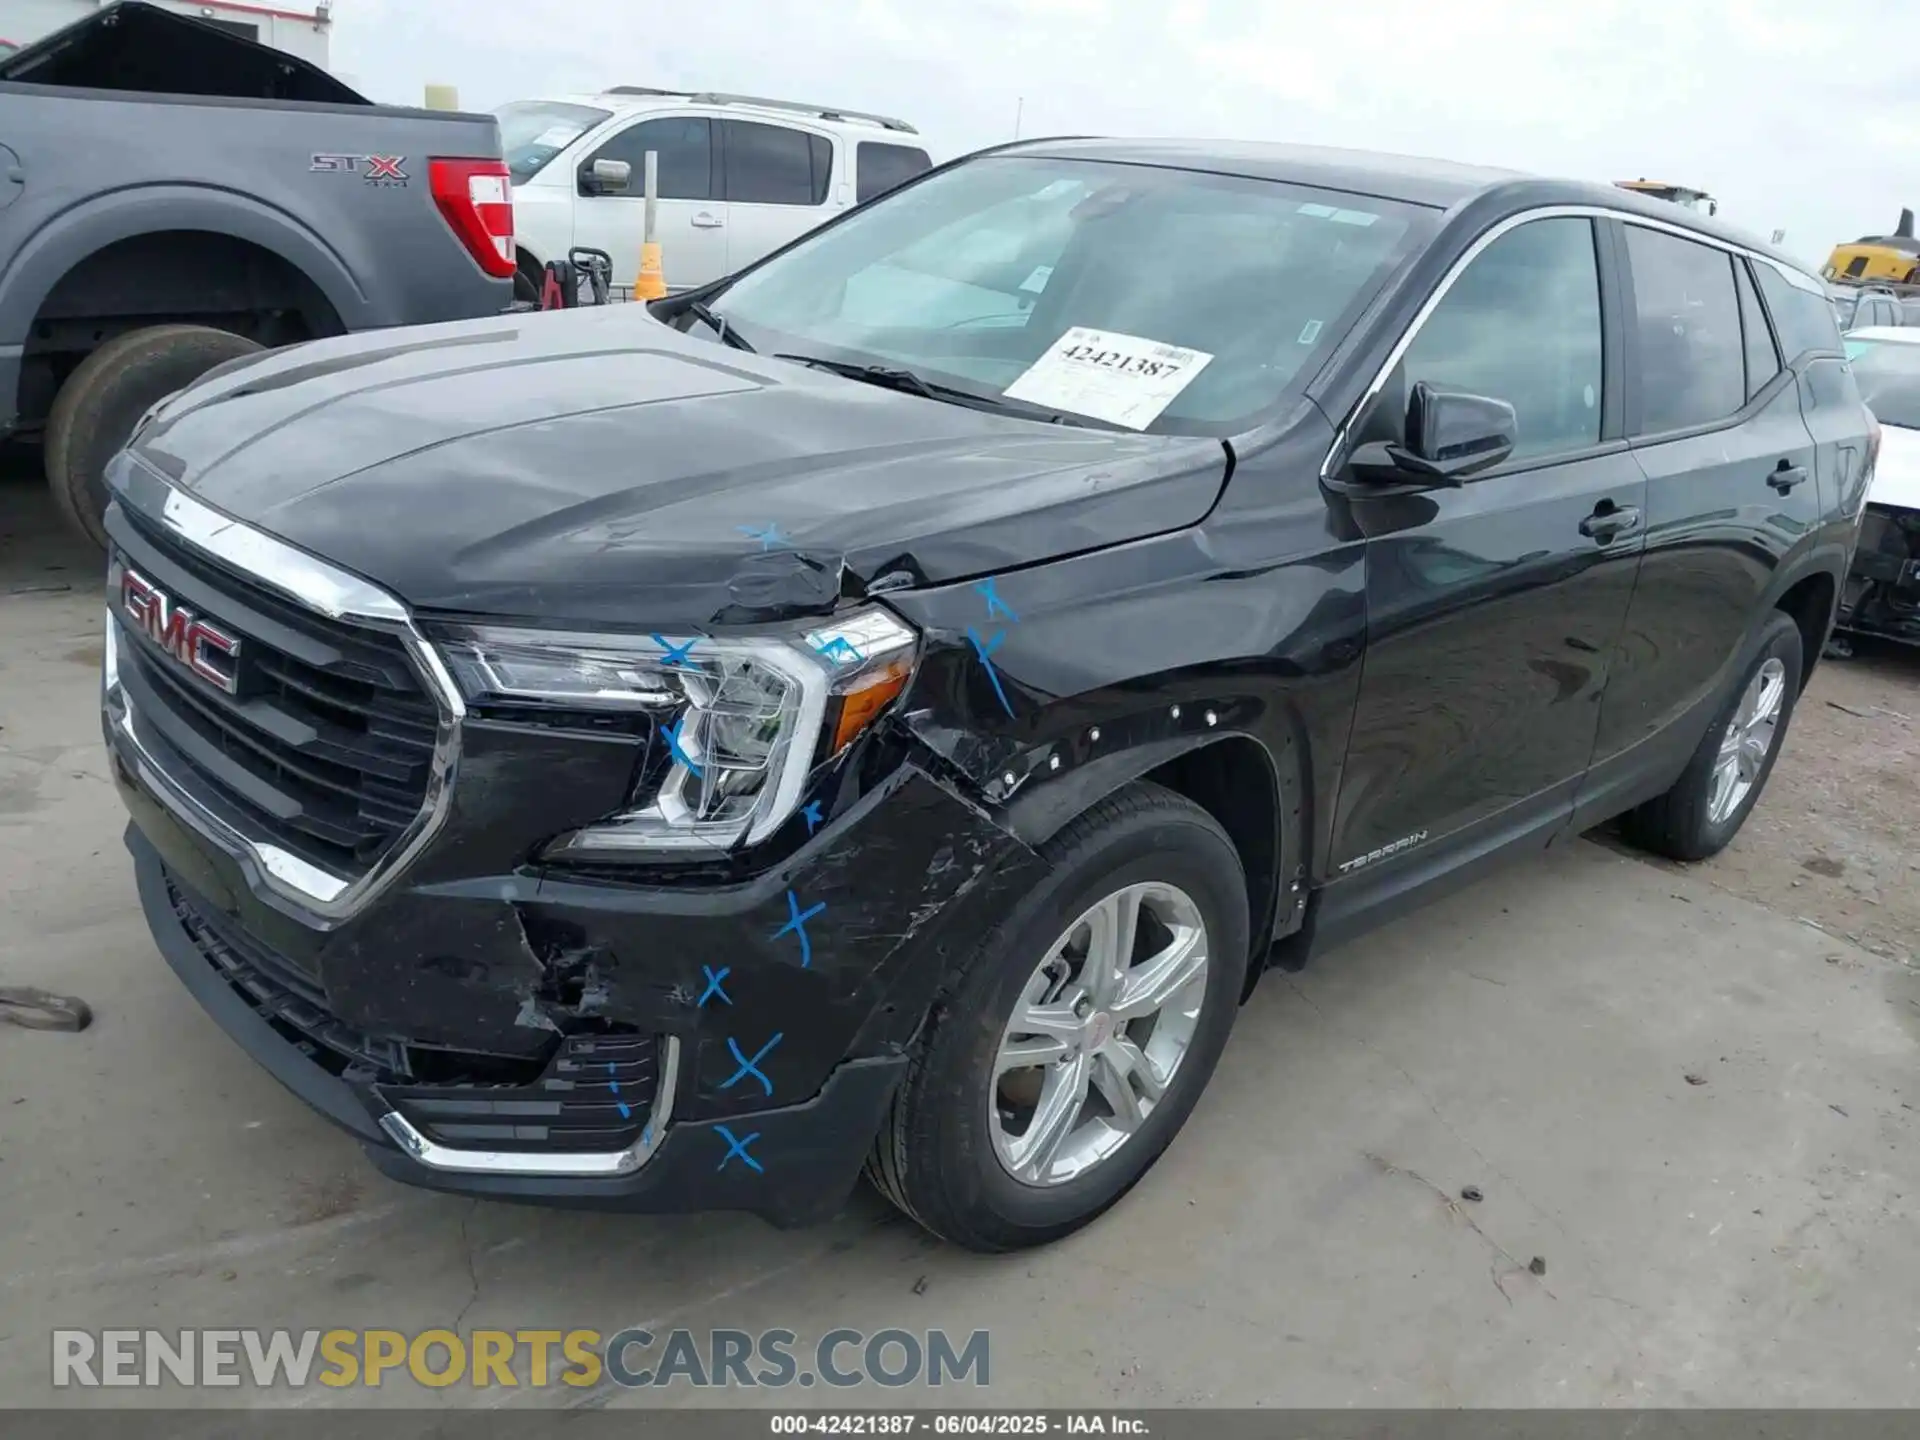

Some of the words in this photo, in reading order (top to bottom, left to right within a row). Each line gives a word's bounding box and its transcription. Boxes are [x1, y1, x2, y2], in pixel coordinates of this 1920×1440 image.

[309, 152, 410, 180] STX
[1062, 344, 1181, 378] 42421387
[122, 568, 241, 695] GMC
[1338, 829, 1428, 873] TERRAIN
